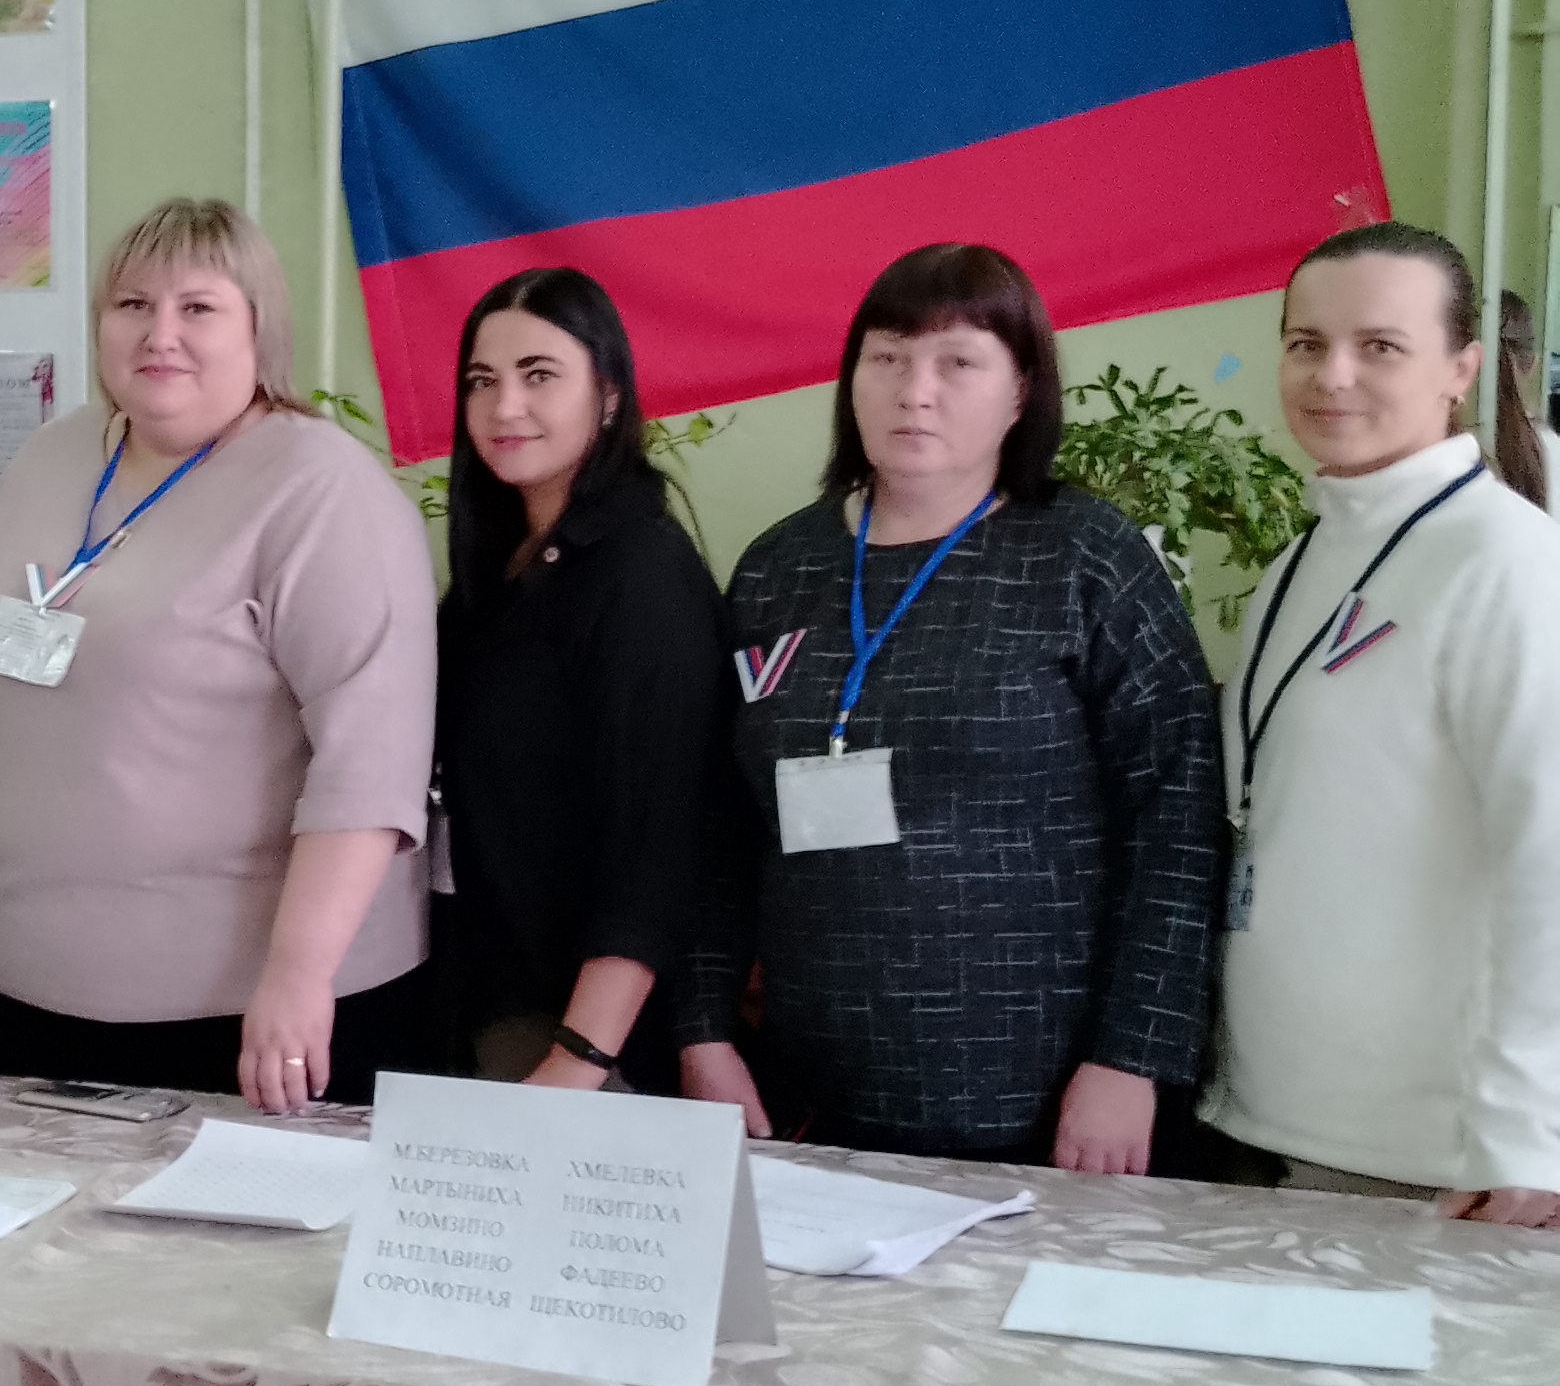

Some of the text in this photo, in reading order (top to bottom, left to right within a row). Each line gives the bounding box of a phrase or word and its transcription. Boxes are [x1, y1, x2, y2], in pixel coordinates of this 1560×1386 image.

[392, 1142, 686, 1189] М.БЕРЕЗОВКА ХМЕЛЕВКА
[388, 1174, 682, 1224] МАРТЫНИХА НИКИТИХА
[396, 1208, 665, 1258] МОМЗИНО ПОЛОМА
[376, 1239, 665, 1293] НАПЛАВИНО ФАДЕЕВО
[363, 1272, 687, 1332] СОРОМОТНАЯ ЩЕКОТИЛОВО
